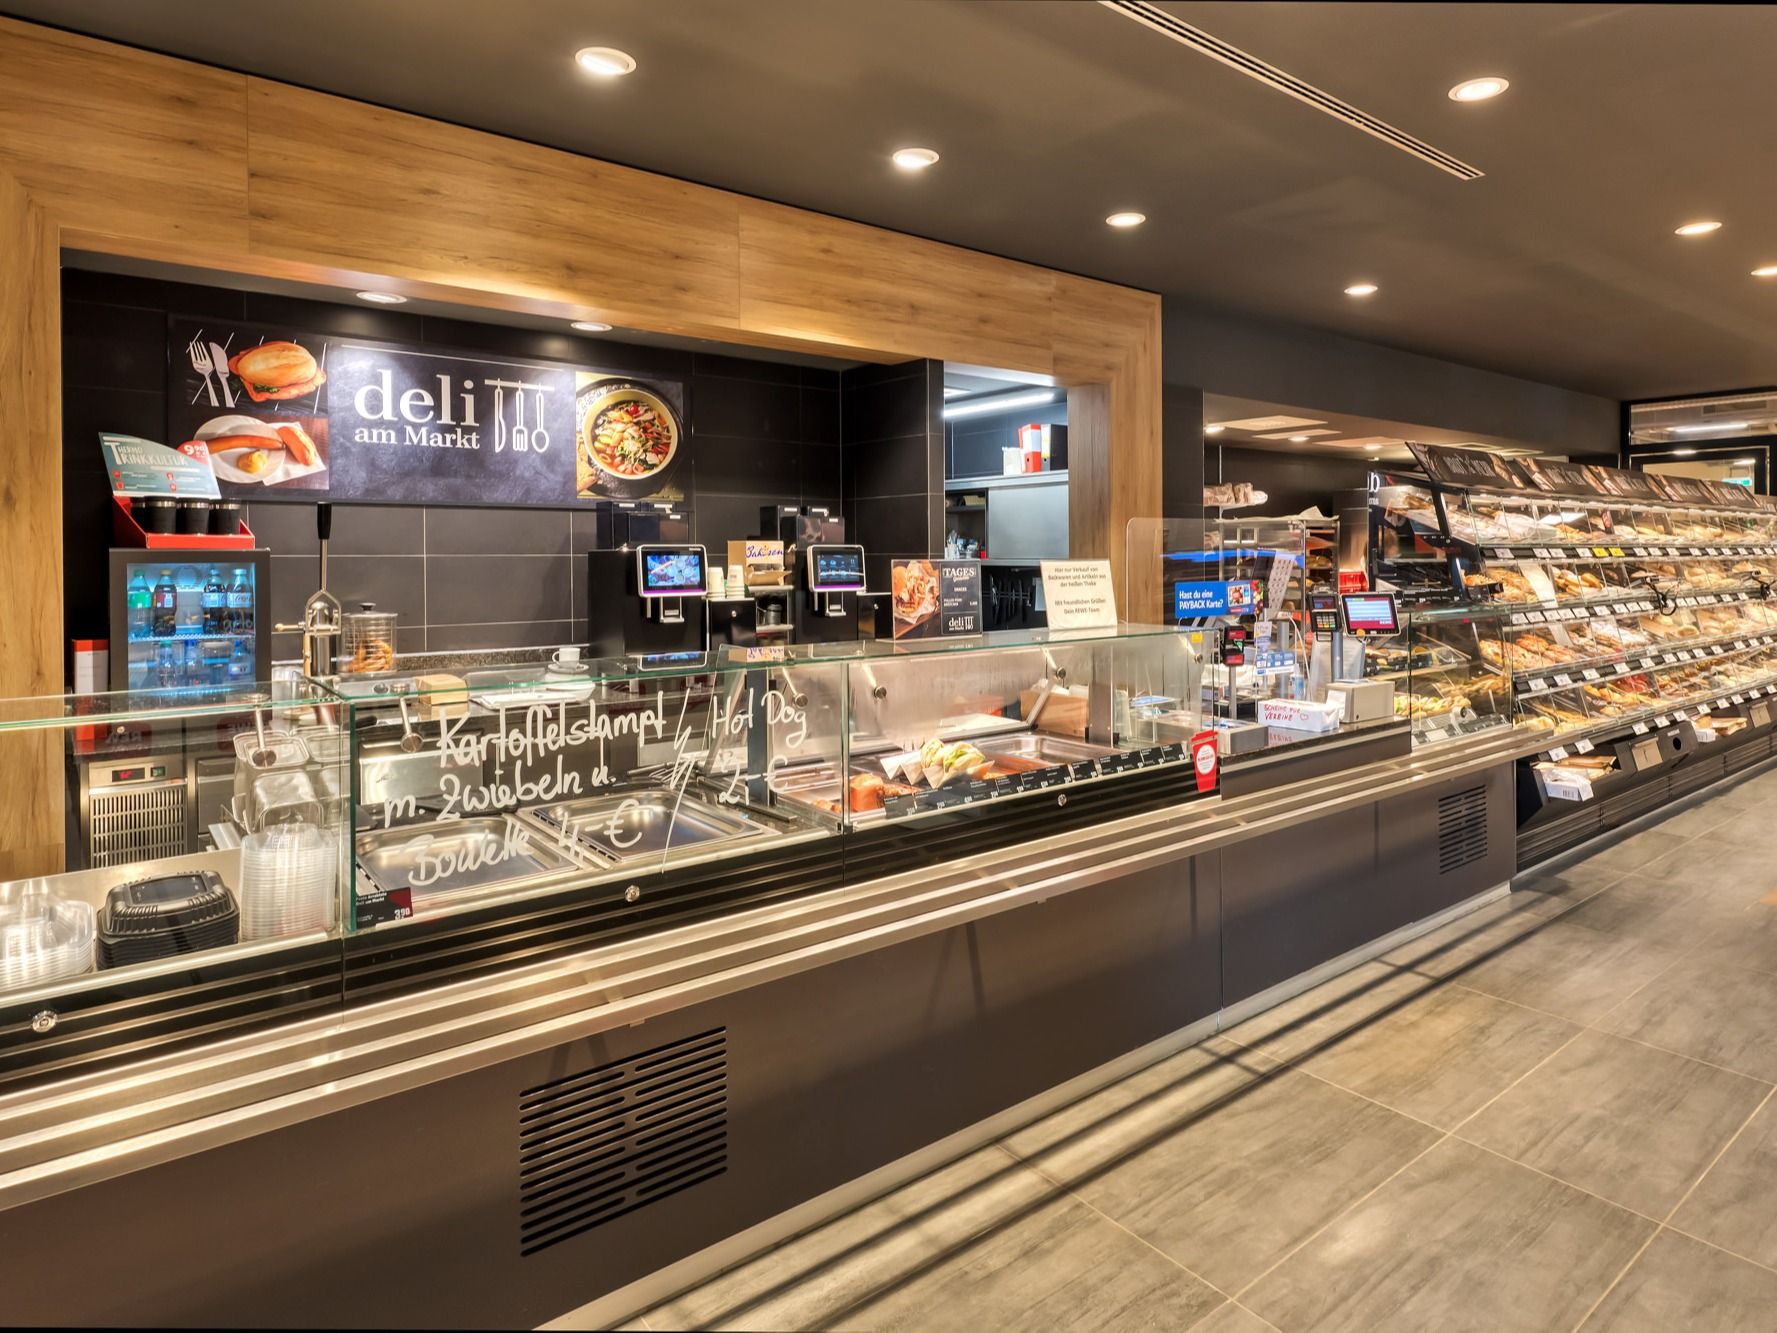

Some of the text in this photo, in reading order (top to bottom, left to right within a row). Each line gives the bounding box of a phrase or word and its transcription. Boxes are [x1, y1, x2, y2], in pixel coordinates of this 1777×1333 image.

[354, 369, 479, 427] deli
[354, 425, 480, 449] am Markt
[944, 567, 975, 577] TAGES
[1179, 589, 1213, 600] Hast du eine
[1179, 599, 1224, 610] PAYBACK Karte?
[949, 617, 964, 627] deli
[712, 688, 807, 748] Hot Dog
[1264, 711, 1293, 721] VEREINE
[437, 690, 666, 767] Kartoffelstampf
[436, 755, 583, 822] Zwiebeln
